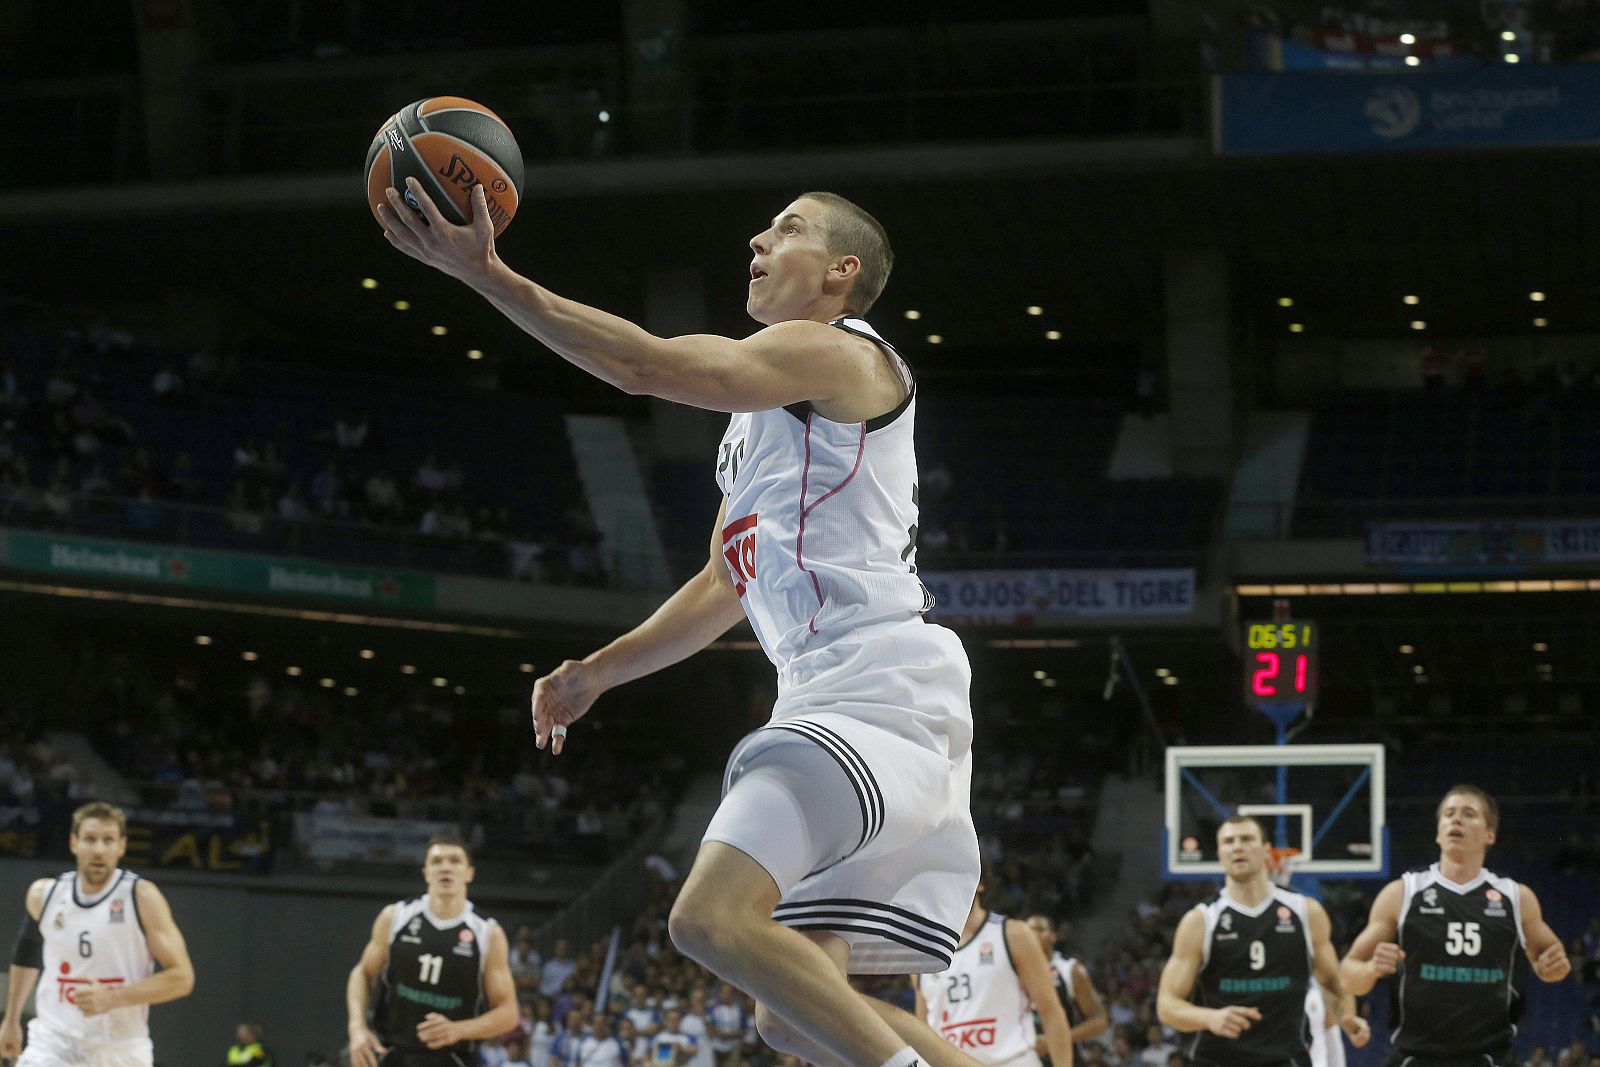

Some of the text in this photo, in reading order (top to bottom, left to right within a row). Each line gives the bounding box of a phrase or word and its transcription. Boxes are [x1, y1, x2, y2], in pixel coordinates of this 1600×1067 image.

[959, 582, 1027, 608] OJOS
[1057, 581, 1105, 608] DEL
[1114, 579, 1190, 607] TIGRE
[1252, 652, 1308, 696] 21
[79, 931, 92, 958] 6
[1445, 922, 1482, 956] 55
[418, 953, 443, 985] 11
[1250, 940, 1266, 971] 9
[948, 974, 972, 1003] 23
